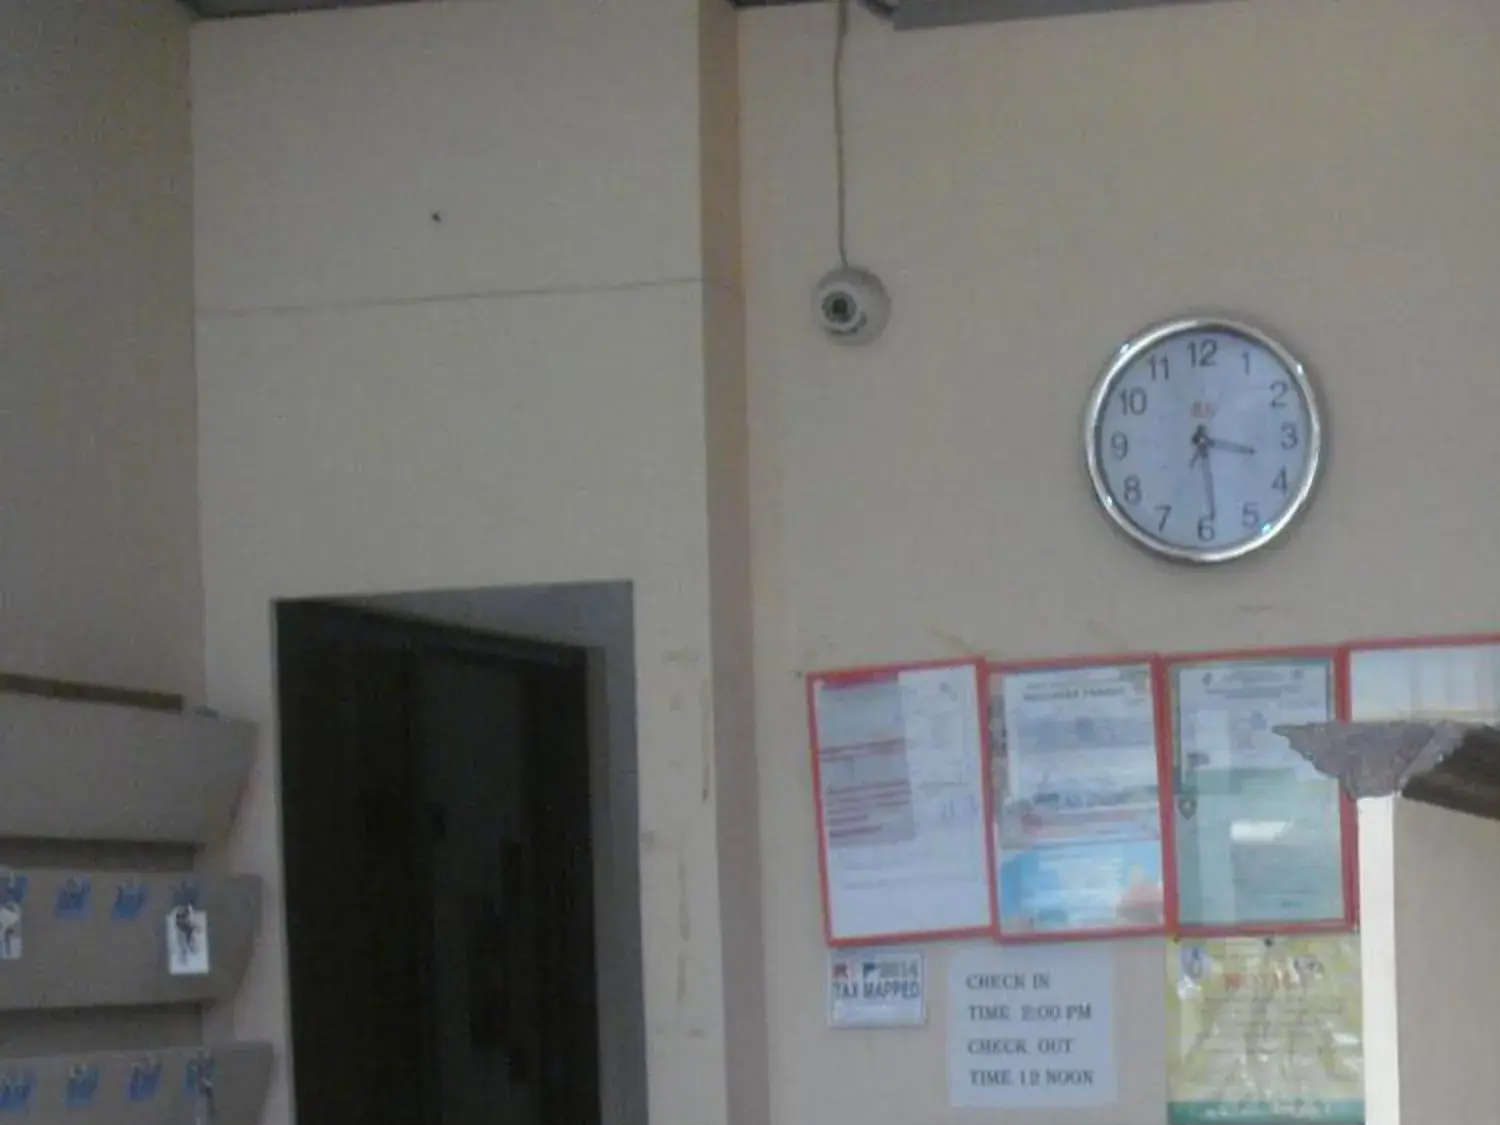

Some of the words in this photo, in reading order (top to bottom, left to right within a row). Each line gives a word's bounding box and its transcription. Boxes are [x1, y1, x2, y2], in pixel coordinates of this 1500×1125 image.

[1188, 339, 1217, 368] 12
[1241, 351, 1251, 375] 1
[1149, 355, 1169, 380] 11
[1120, 387, 1147, 416] 10
[1269, 380, 1288, 408] 2
[1111, 432, 1128, 460] 9
[1280, 422, 1298, 450] 3
[1123, 474, 1142, 504] 8
[1271, 467, 1288, 495] 4
[1154, 505, 1172, 533] 7
[1241, 503, 1260, 528] 5
[1197, 517, 1215, 542] 6
[832, 982, 857, 998] TAX
[863, 981, 919, 999] MAPPED
[966, 973, 1025, 990] CHECK
[1033, 973, 1051, 990] IN
[968, 1004, 1010, 1021] TIME
[1065, 1003, 1092, 1021] PM
[967, 1037, 1028, 1055] CHECK
[1037, 1037, 1074, 1055] OUT
[969, 1069, 1012, 1087] TIME
[1046, 1069, 1095, 1087] NOON
